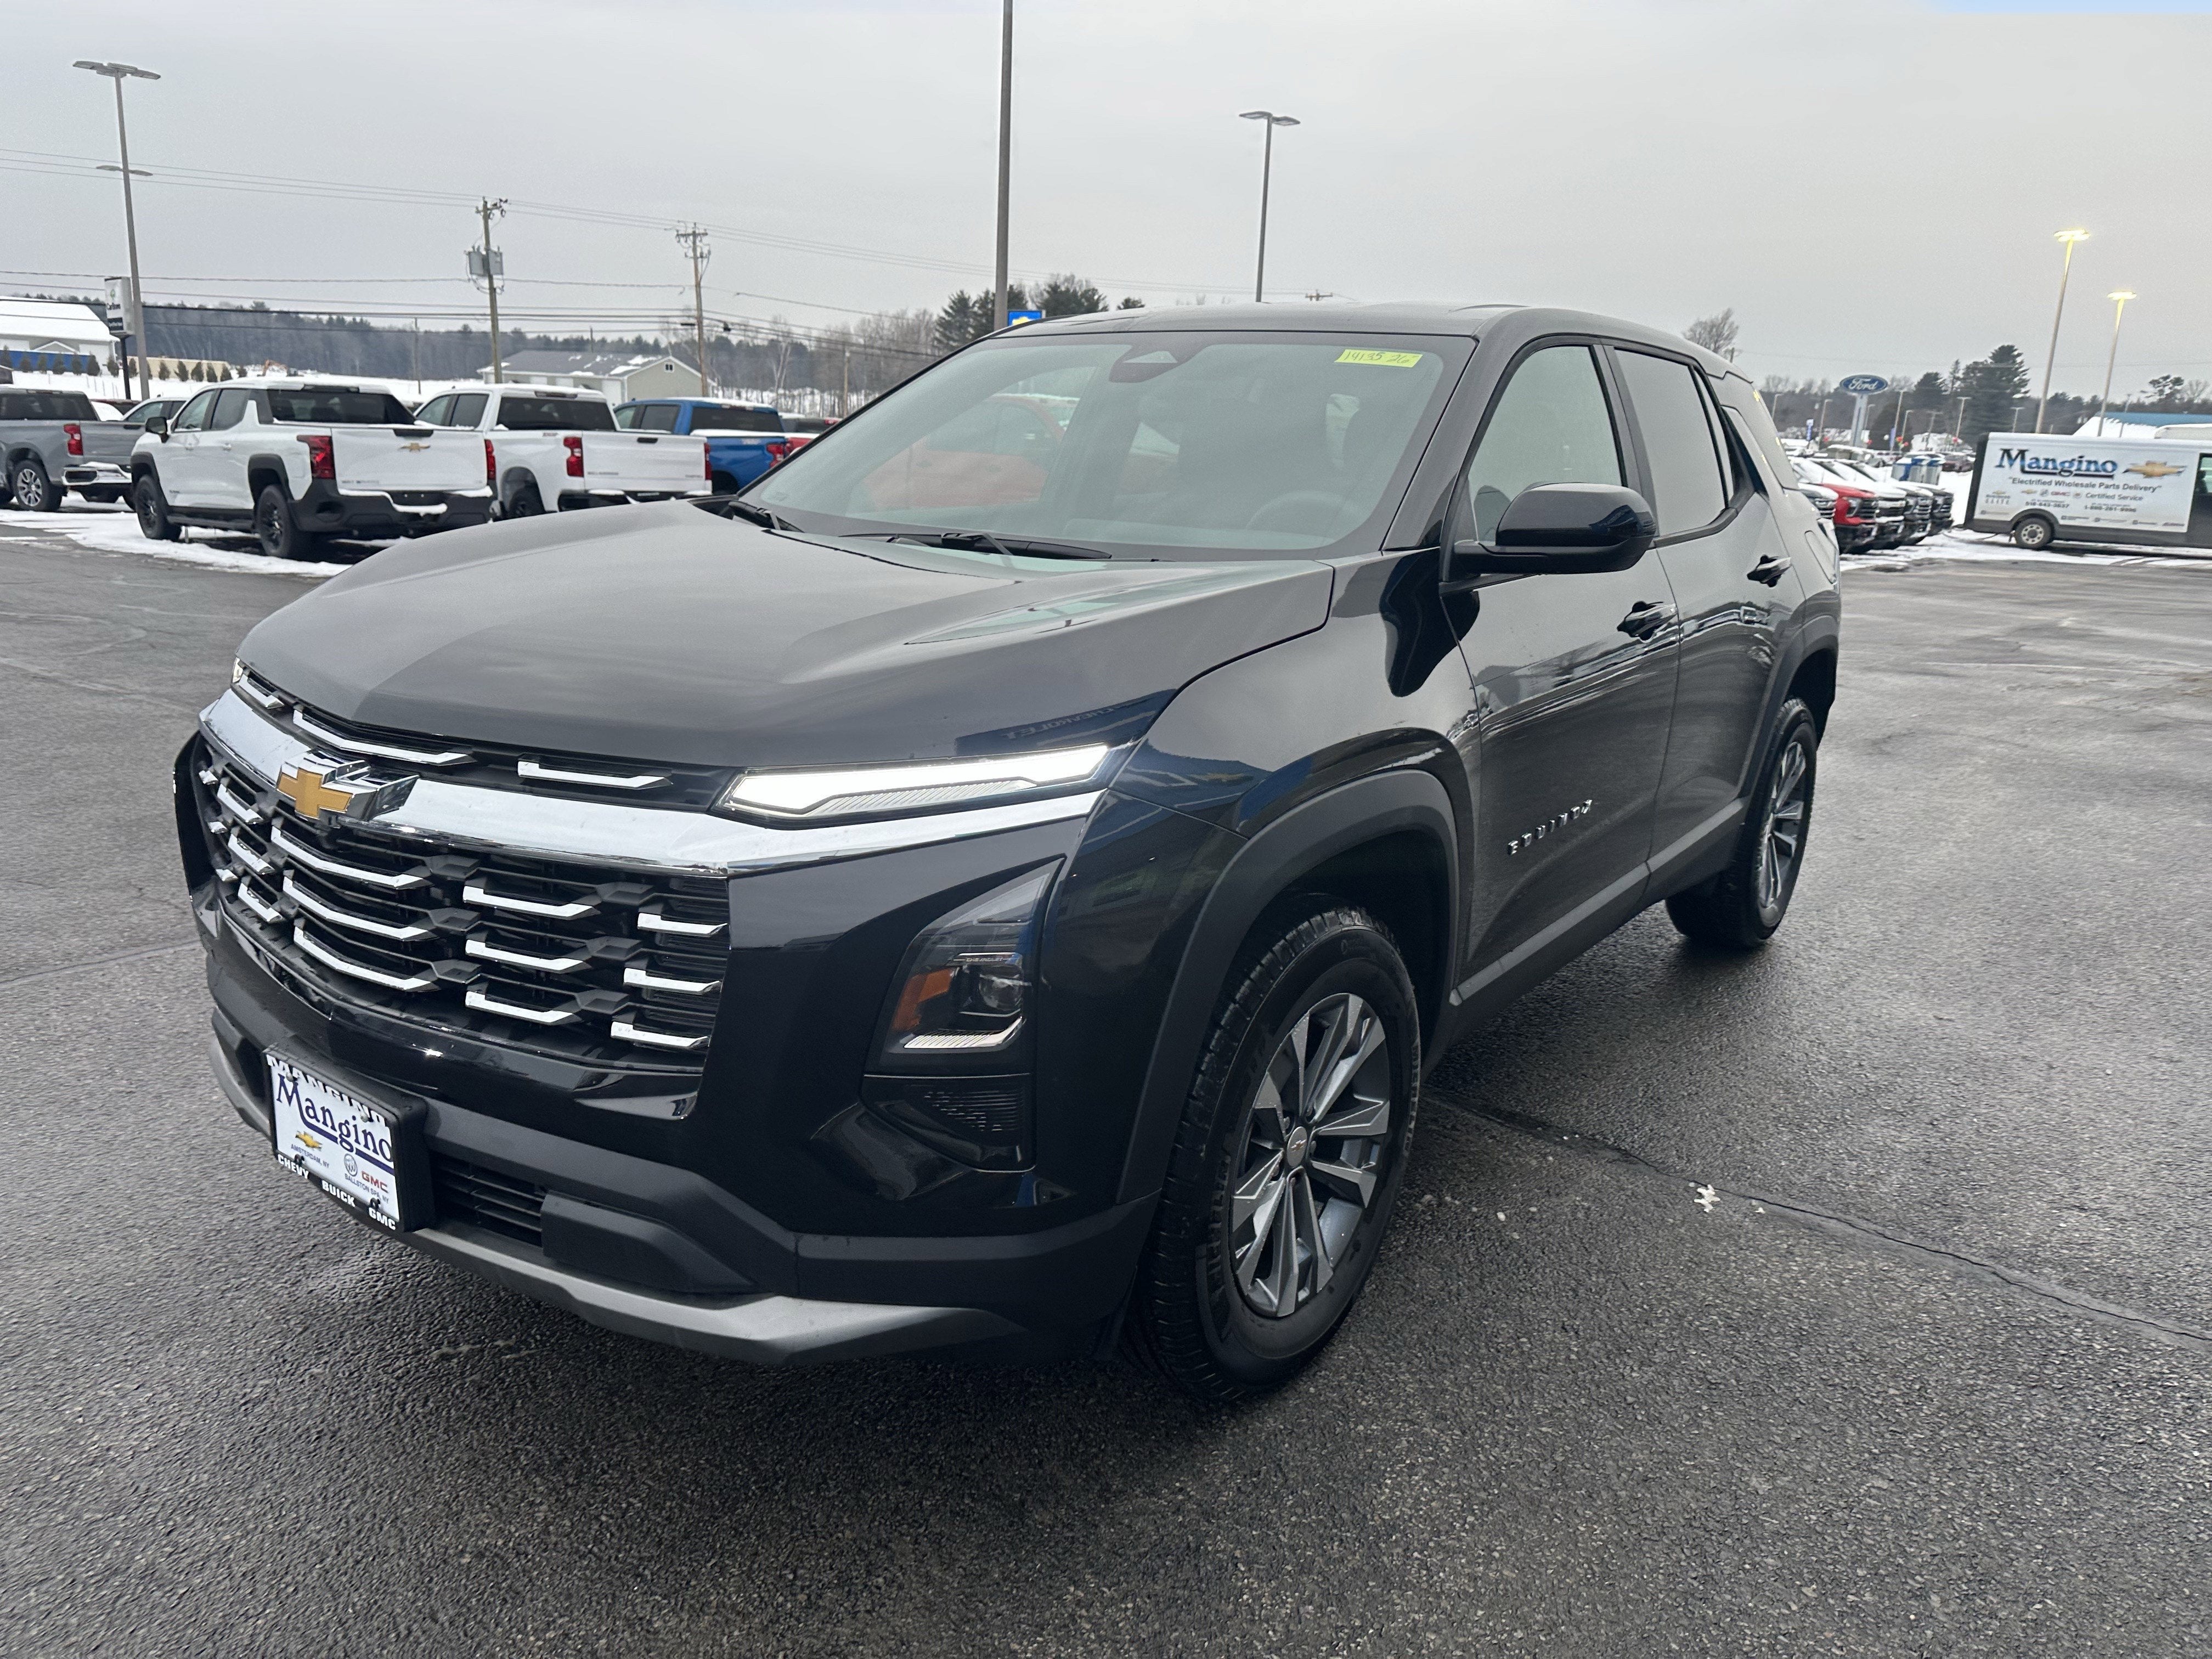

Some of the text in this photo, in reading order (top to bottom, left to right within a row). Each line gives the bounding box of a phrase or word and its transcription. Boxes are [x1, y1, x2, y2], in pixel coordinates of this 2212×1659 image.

[1848, 378, 1878, 390] Ford
[1995, 448, 2118, 477] Mangino
[2098, 482, 2120, 490] Parts
[1508, 799, 1593, 856] EQUINOX
[276, 1073, 393, 1163] Mangino
[278, 1154, 309, 1179] CHEVY
[321, 1180, 356, 1207] BUICK
[362, 1171, 388, 1193] GMC
[369, 1207, 396, 1231] GMC
